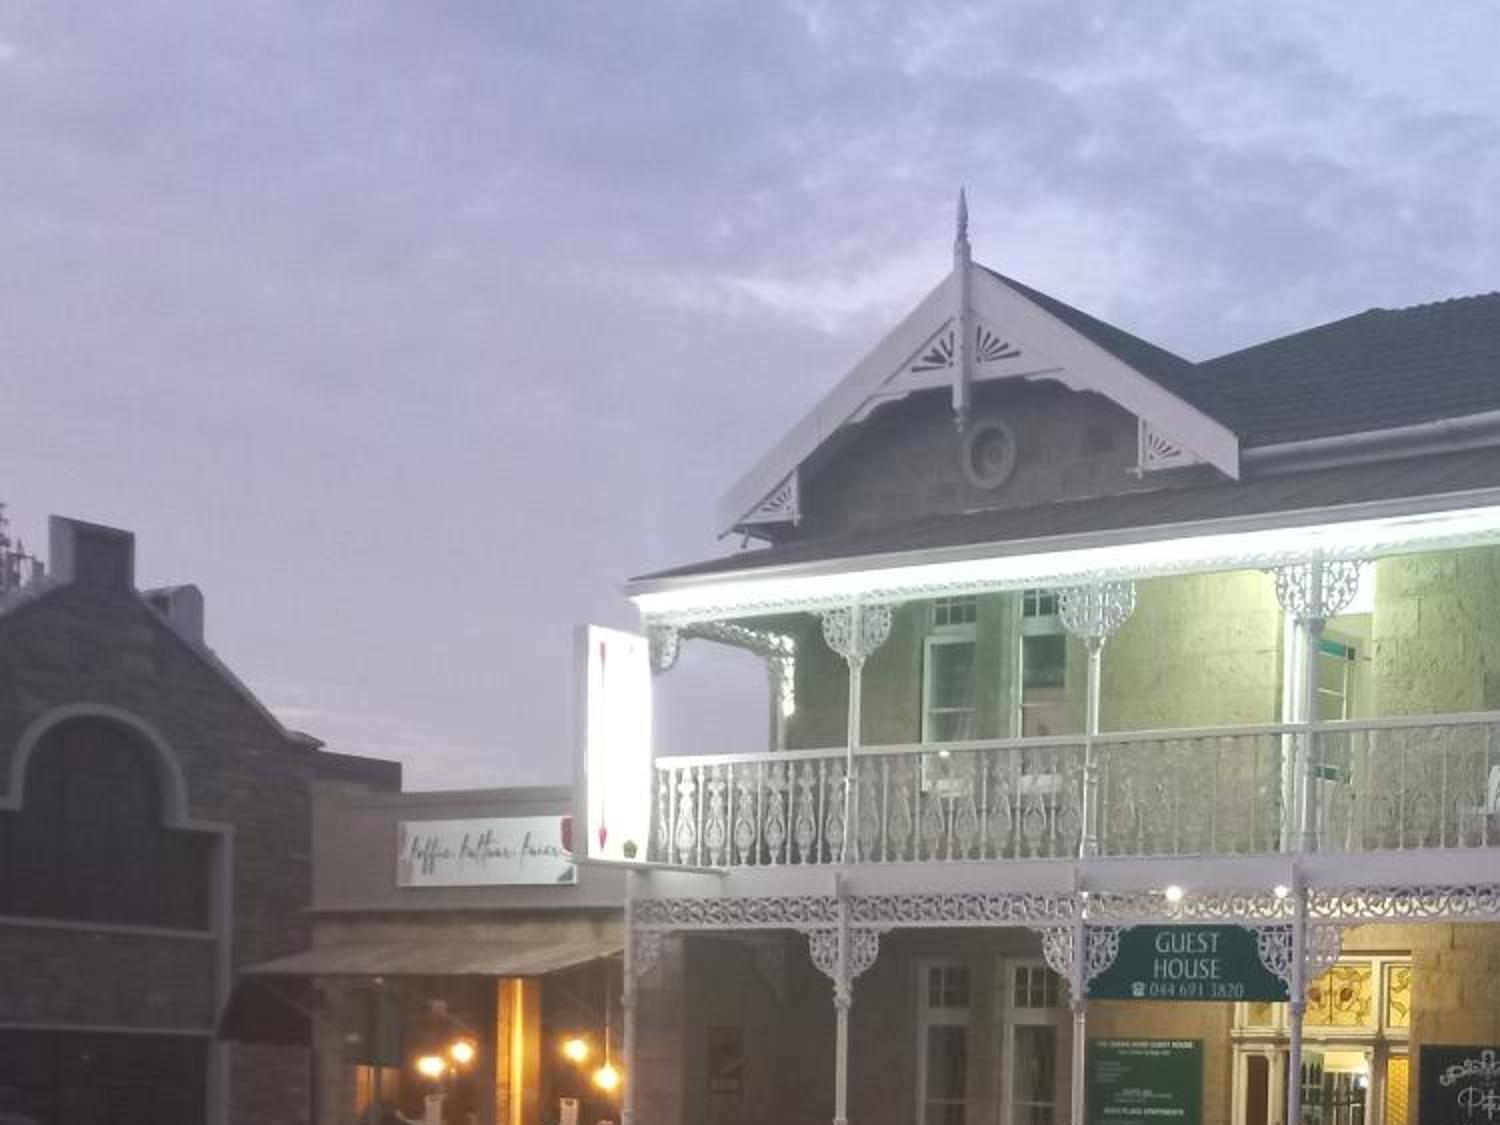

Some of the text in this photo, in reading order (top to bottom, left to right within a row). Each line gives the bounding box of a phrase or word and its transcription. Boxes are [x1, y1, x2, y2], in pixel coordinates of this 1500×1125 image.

[1154, 930, 1222, 954] GUEST
[1152, 957, 1222, 980] HOUSE
[1149, 982, 1175, 997] 044
